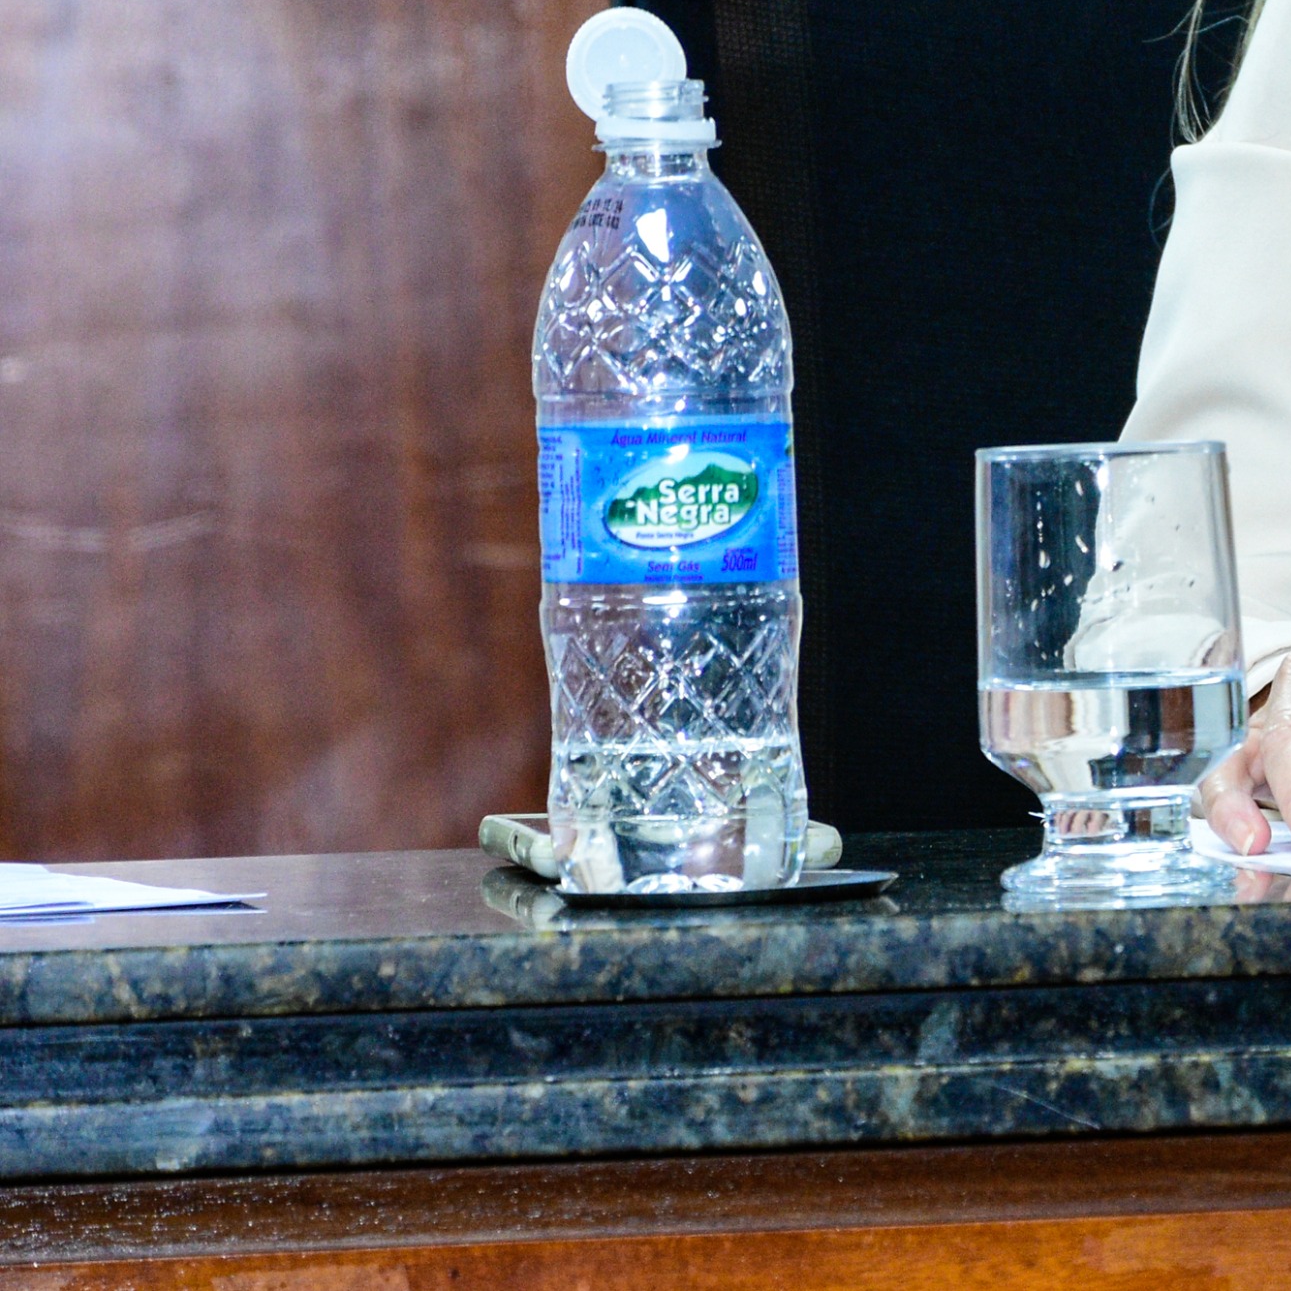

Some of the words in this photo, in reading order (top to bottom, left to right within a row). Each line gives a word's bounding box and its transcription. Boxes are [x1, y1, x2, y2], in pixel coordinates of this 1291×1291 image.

[611, 429, 643, 448] Água
[646, 431, 697, 445] Mineral
[701, 429, 747, 444] Natural
[658, 478, 740, 505] Serra
[636, 498, 731, 531] Negra
[677, 560, 701, 573] Gás
[721, 552, 759, 573] 500ml
